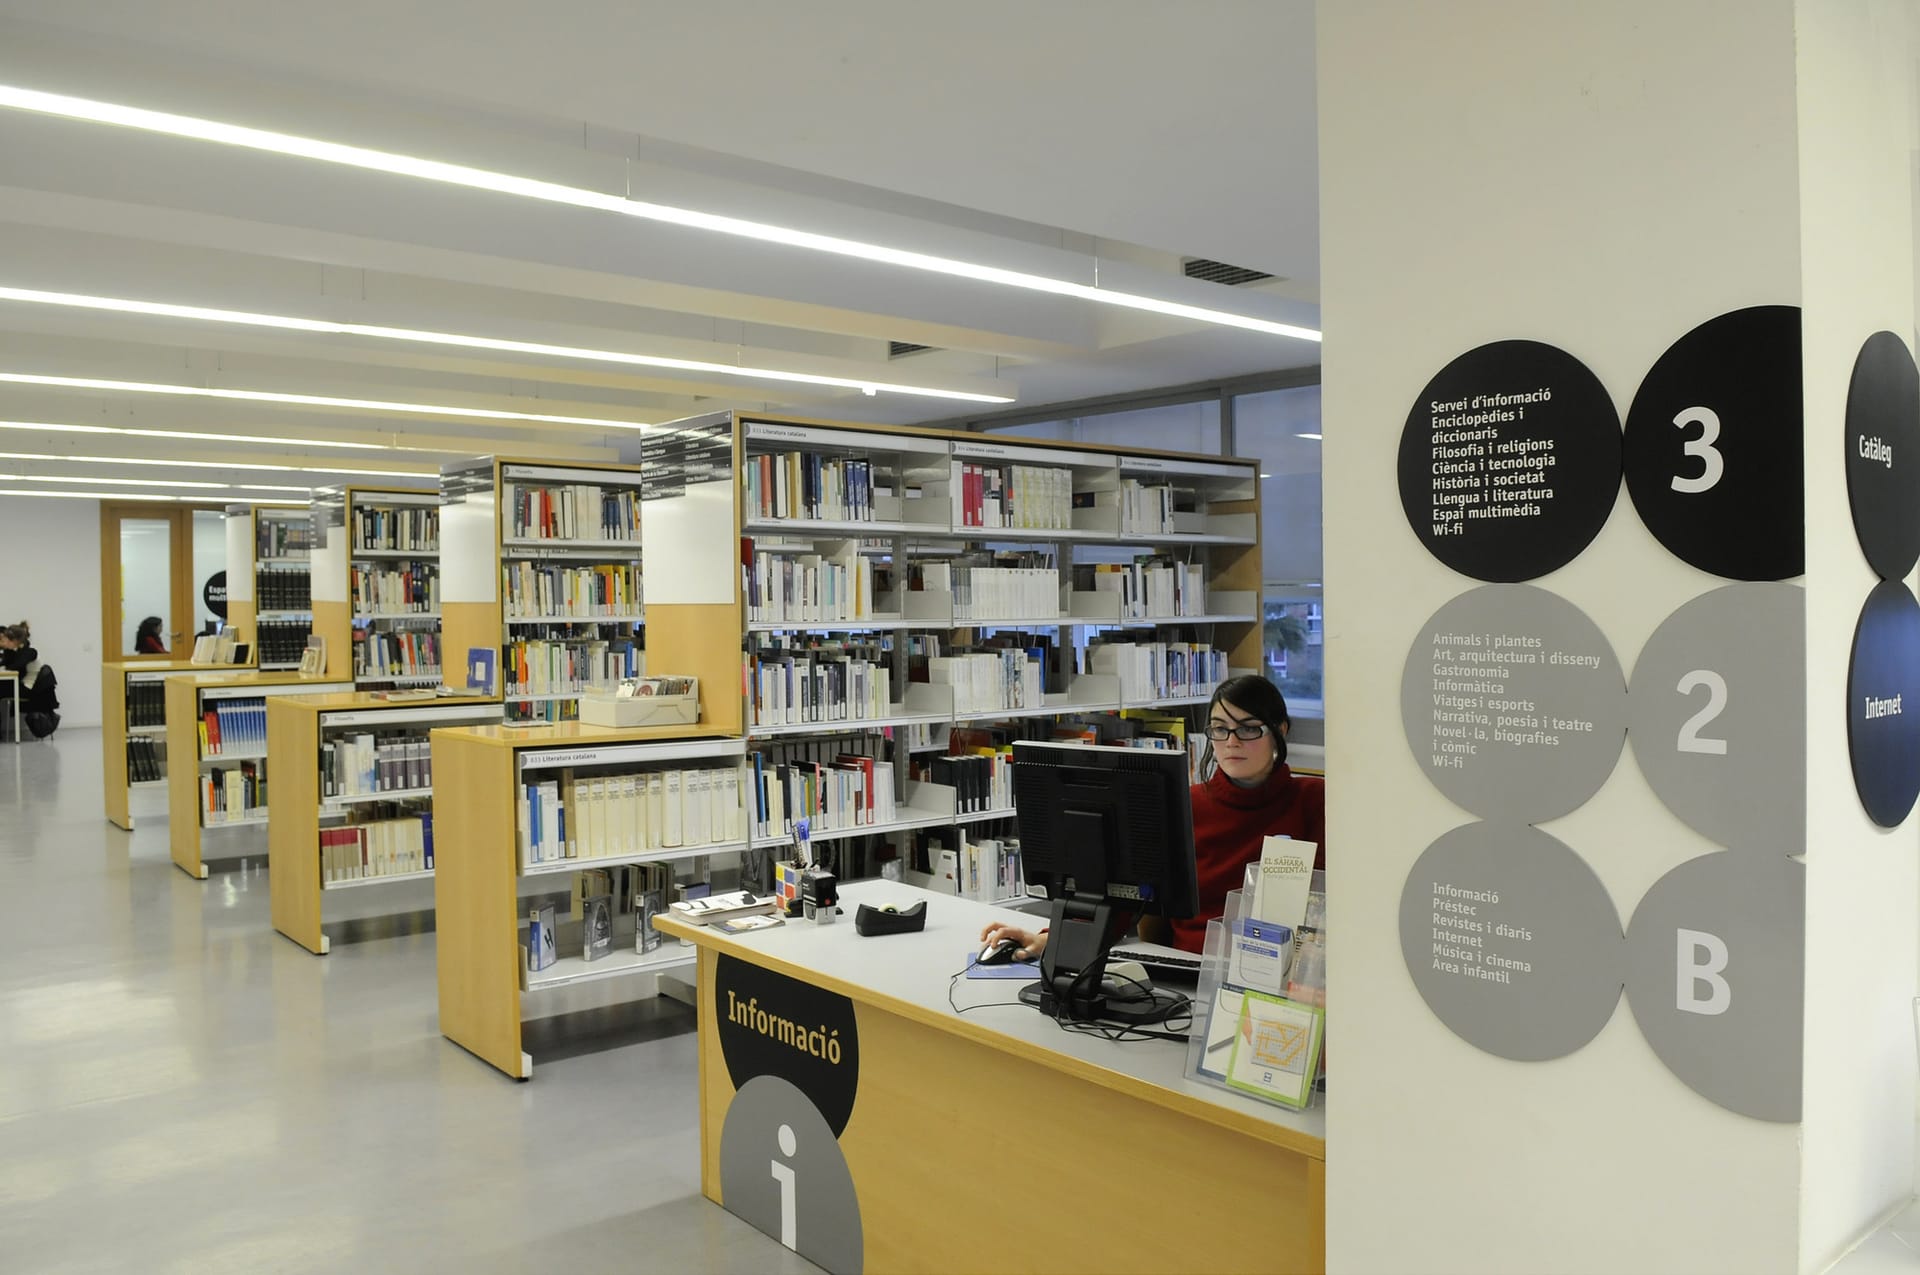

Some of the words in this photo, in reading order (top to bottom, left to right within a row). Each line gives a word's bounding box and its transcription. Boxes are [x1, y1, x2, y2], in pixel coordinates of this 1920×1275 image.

[1431, 397, 1467, 413] Servei
[1472, 388, 1551, 410] d'informació
[1432, 409, 1515, 428] Enciclopèdies
[1519, 407, 1523, 419] i
[1432, 426, 1498, 445] diccionaris
[1433, 443, 1484, 459] Filosofia
[1488, 442, 1492, 454] i
[1497, 438, 1554, 456] religions
[1671, 406, 1724, 493] 3
[1859, 435, 1891, 468] Catàleg
[1432, 460, 1475, 474] Ciència
[1479, 459, 1484, 471] i
[1488, 453, 1555, 470] tecnologia
[1433, 475, 1480, 489] Història
[1484, 474, 1489, 486] i
[1493, 471, 1545, 486] societat
[1433, 493, 1480, 509] Llengua
[1484, 490, 1488, 502] i
[1493, 488, 1553, 502] literatura
[1433, 507, 1463, 523] Espai
[1468, 503, 1540, 518] multimèdia
[1433, 522, 1463, 536] Wi-fi
[1433, 633, 1481, 646] Animals
[1485, 634, 1489, 646] i
[1495, 635, 1541, 649] plantes
[1433, 648, 1455, 662] Art,
[1460, 650, 1535, 664] arquitectura
[1540, 651, 1545, 663] i
[1550, 651, 1600, 669] disseny
[1433, 663, 1509, 678] Gastronomia
[1433, 679, 1504, 694] Informàtica
[1433, 694, 1477, 710] Viatges
[1479, 696, 1483, 708] i
[1488, 700, 1534, 712] esports
[1677, 670, 1727, 755] 2
[1865, 694, 1902, 719] Internet
[1434, 709, 1491, 726] Narrativa,
[1497, 715, 1538, 732] poesia
[1543, 716, 1547, 728] i
[1552, 718, 1592, 732] teatre
[1434, 725, 1488, 741] Novel·la,
[1494, 728, 1559, 745] biografies
[1433, 739, 1437, 751] i
[1441, 740, 1476, 754] còmic
[542, 755, 571, 763] Literatura
[572, 753, 597, 761] catalana
[1432, 755, 1463, 768] Wi-fi
[1262, 866, 1308, 874] OCCIDENTAL
[1264, 857, 1272, 865] EL
[1433, 882, 1499, 904] Informació
[1433, 898, 1476, 915] Préstec
[1433, 913, 1482, 931] Revistes
[1487, 921, 1491, 933] i
[1496, 924, 1532, 941] diaris
[1433, 928, 1482, 948] Internet
[1433, 943, 1473, 961] Música
[1477, 951, 1481, 962] i
[1486, 954, 1531, 972] cinema
[1432, 955, 1459, 974] Àrea
[1463, 963, 1510, 984] infantil
[1677, 928, 1731, 1015] B
[728, 990, 840, 1064] Informació
[771, 1124, 796, 1251] i
